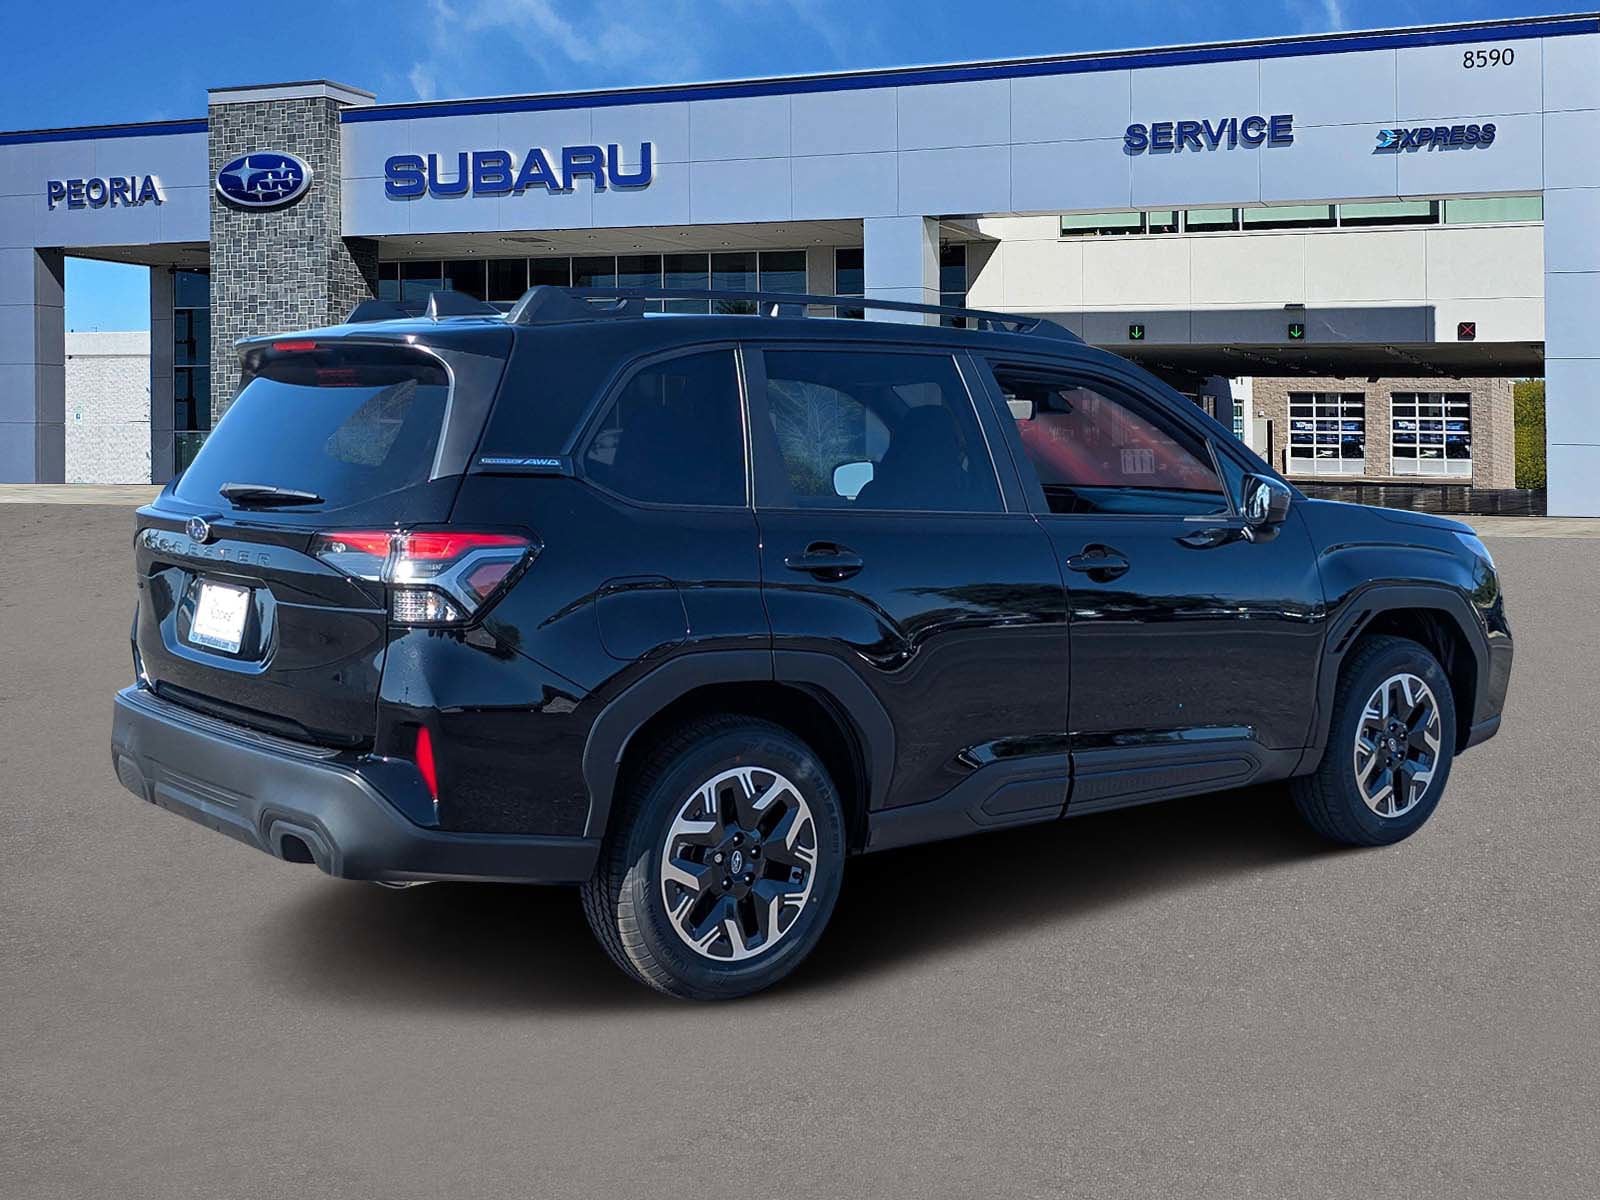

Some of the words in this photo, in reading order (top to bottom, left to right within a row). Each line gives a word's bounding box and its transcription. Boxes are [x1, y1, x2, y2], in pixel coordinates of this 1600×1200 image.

[1462, 48, 1514, 69] 8590
[1124, 114, 1294, 154] SERVICE
[1375, 123, 1497, 152] EXPRESS
[384, 141, 653, 200] SUBARU
[47, 174, 162, 209] PEORIA
[523, 458, 560, 466] AWD
